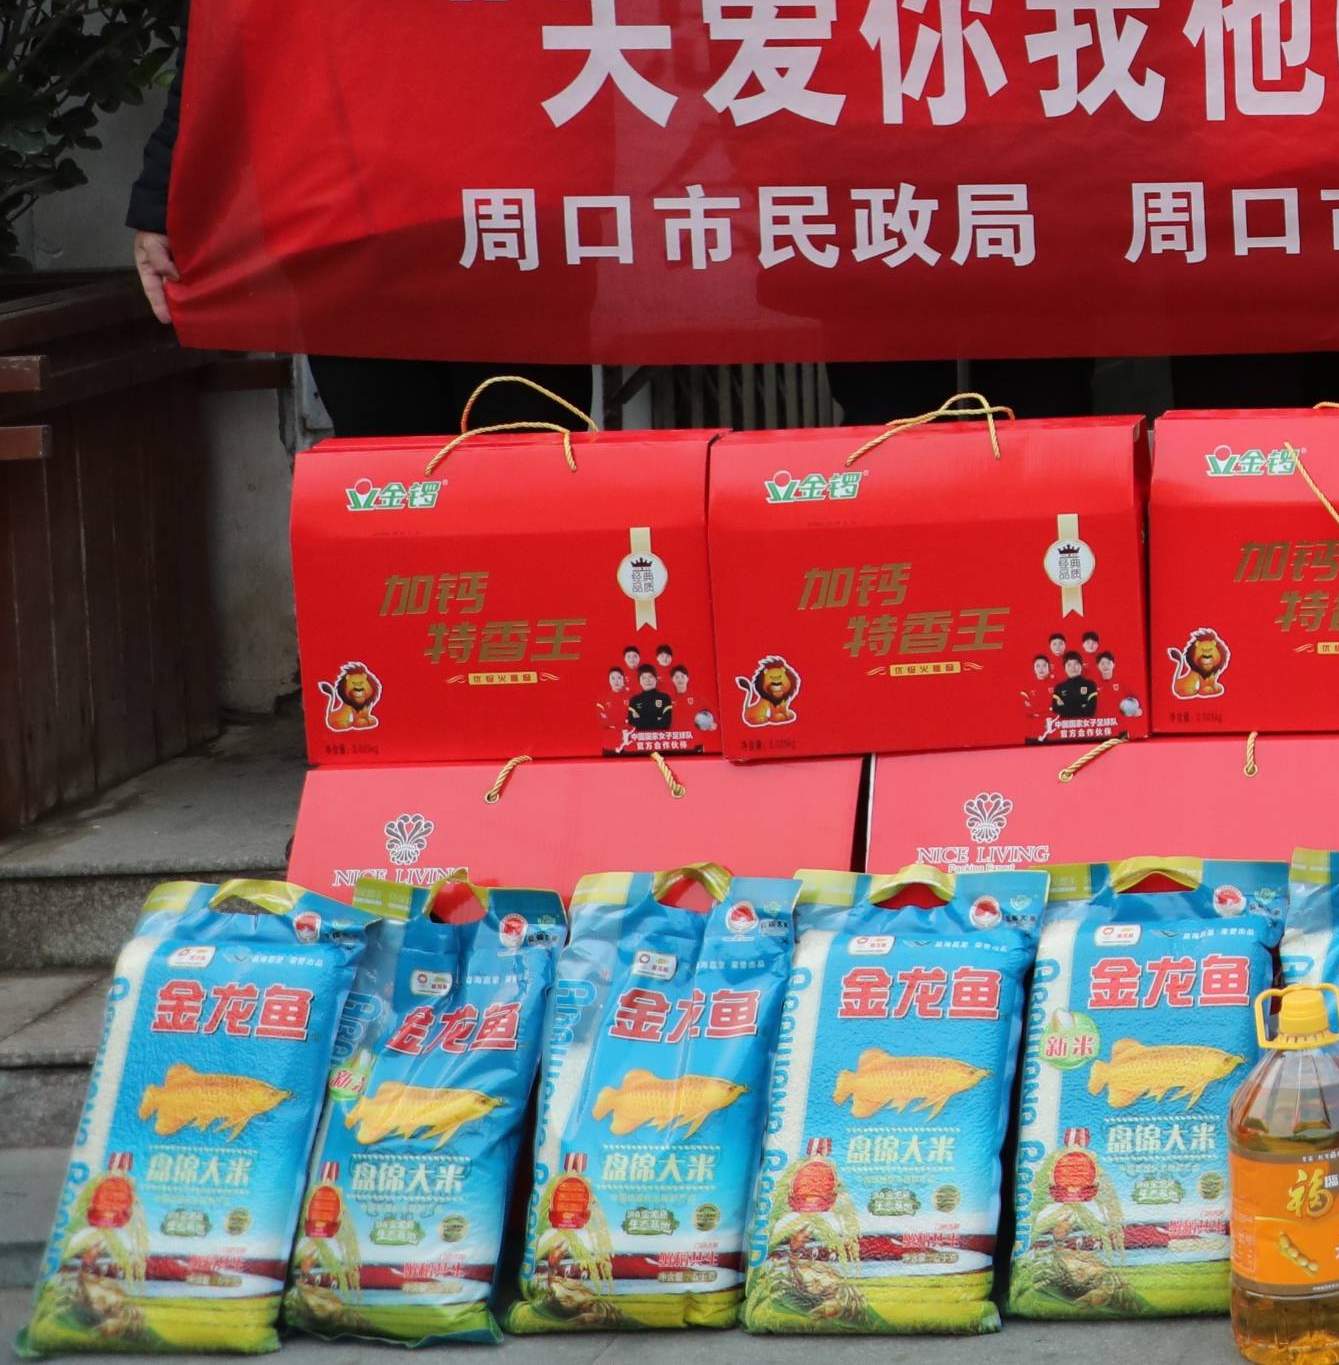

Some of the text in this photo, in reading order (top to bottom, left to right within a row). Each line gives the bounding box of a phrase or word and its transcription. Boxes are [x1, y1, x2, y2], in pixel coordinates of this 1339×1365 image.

[458, 183, 1037, 272] 周口市民政局
[380, 572, 489, 616] 加钙
[798, 563, 912, 610] 加钙
[424, 618, 587, 664] 特香王
[843, 607, 1010, 656] 特香王
[916, 846, 1050, 863] NICE LIVING
[837, 966, 1001, 1020] 金龙鱼
[1088, 954, 1250, 1008] 金龙鱼
[151, 979, 314, 1041] 金龙鱼
[385, 1003, 523, 1055] 金龙鱼
[608, 987, 762, 1044] 金龙鱼
[1045, 1035, 1093, 1056] 新米
[847, 1134, 956, 1164] 盘锦大米
[1107, 1123, 1217, 1153] 盘锦大米
[602, 1152, 716, 1182] 盘锦大米
